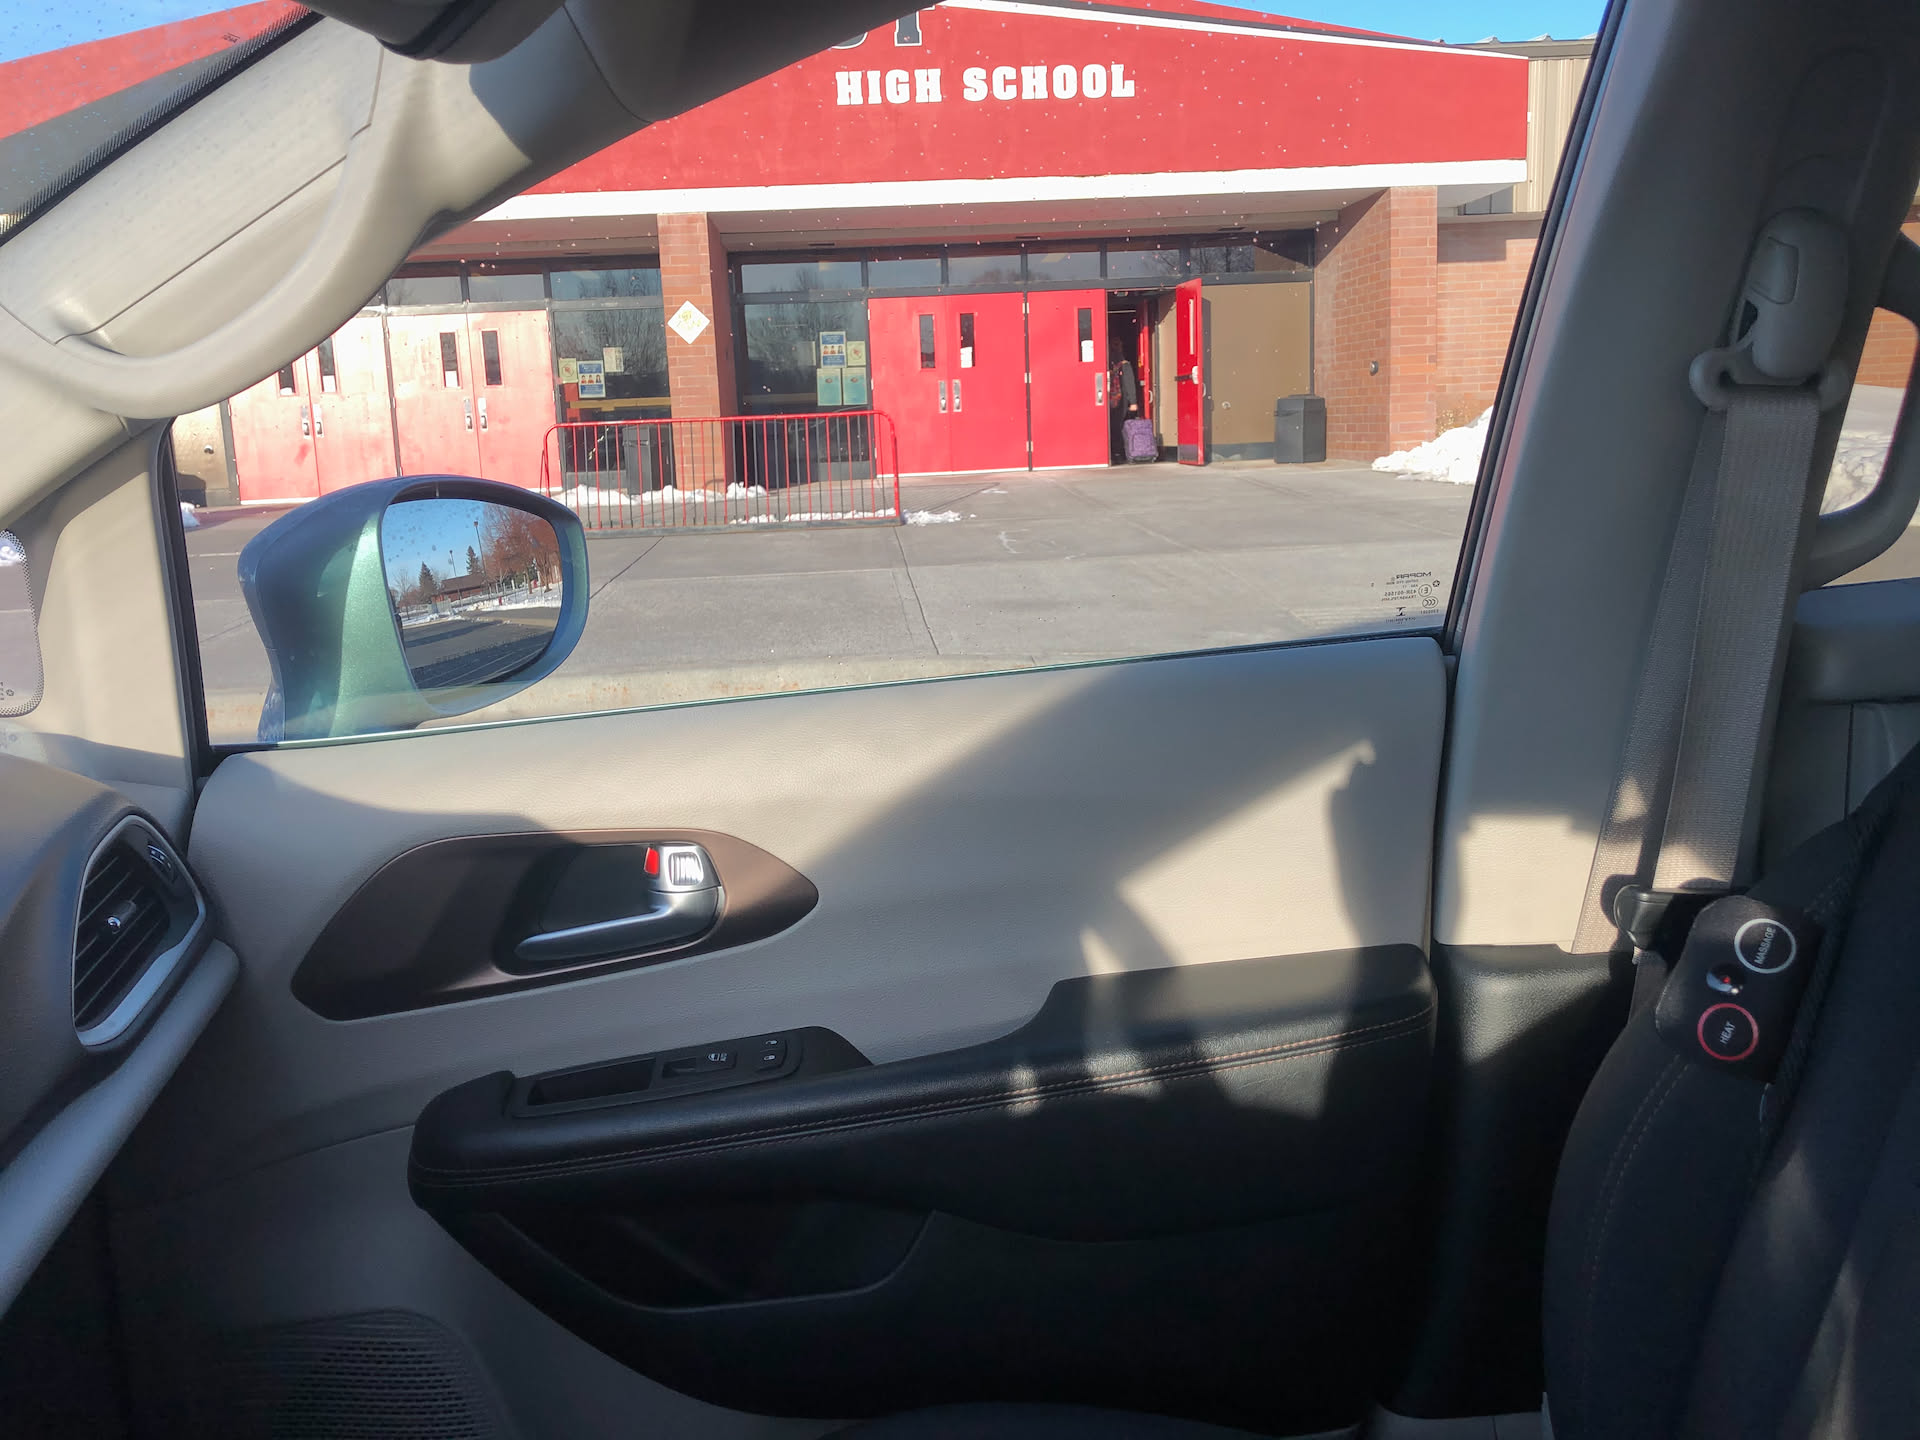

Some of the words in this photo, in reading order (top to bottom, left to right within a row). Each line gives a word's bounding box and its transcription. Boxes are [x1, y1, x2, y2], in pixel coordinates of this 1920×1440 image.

[835, 68, 943, 106] HIGH
[962, 63, 1135, 101] SCHOOL
[1754, 926, 1776, 965] MASSAGE
[1720, 1020, 1736, 1045] HEAT
